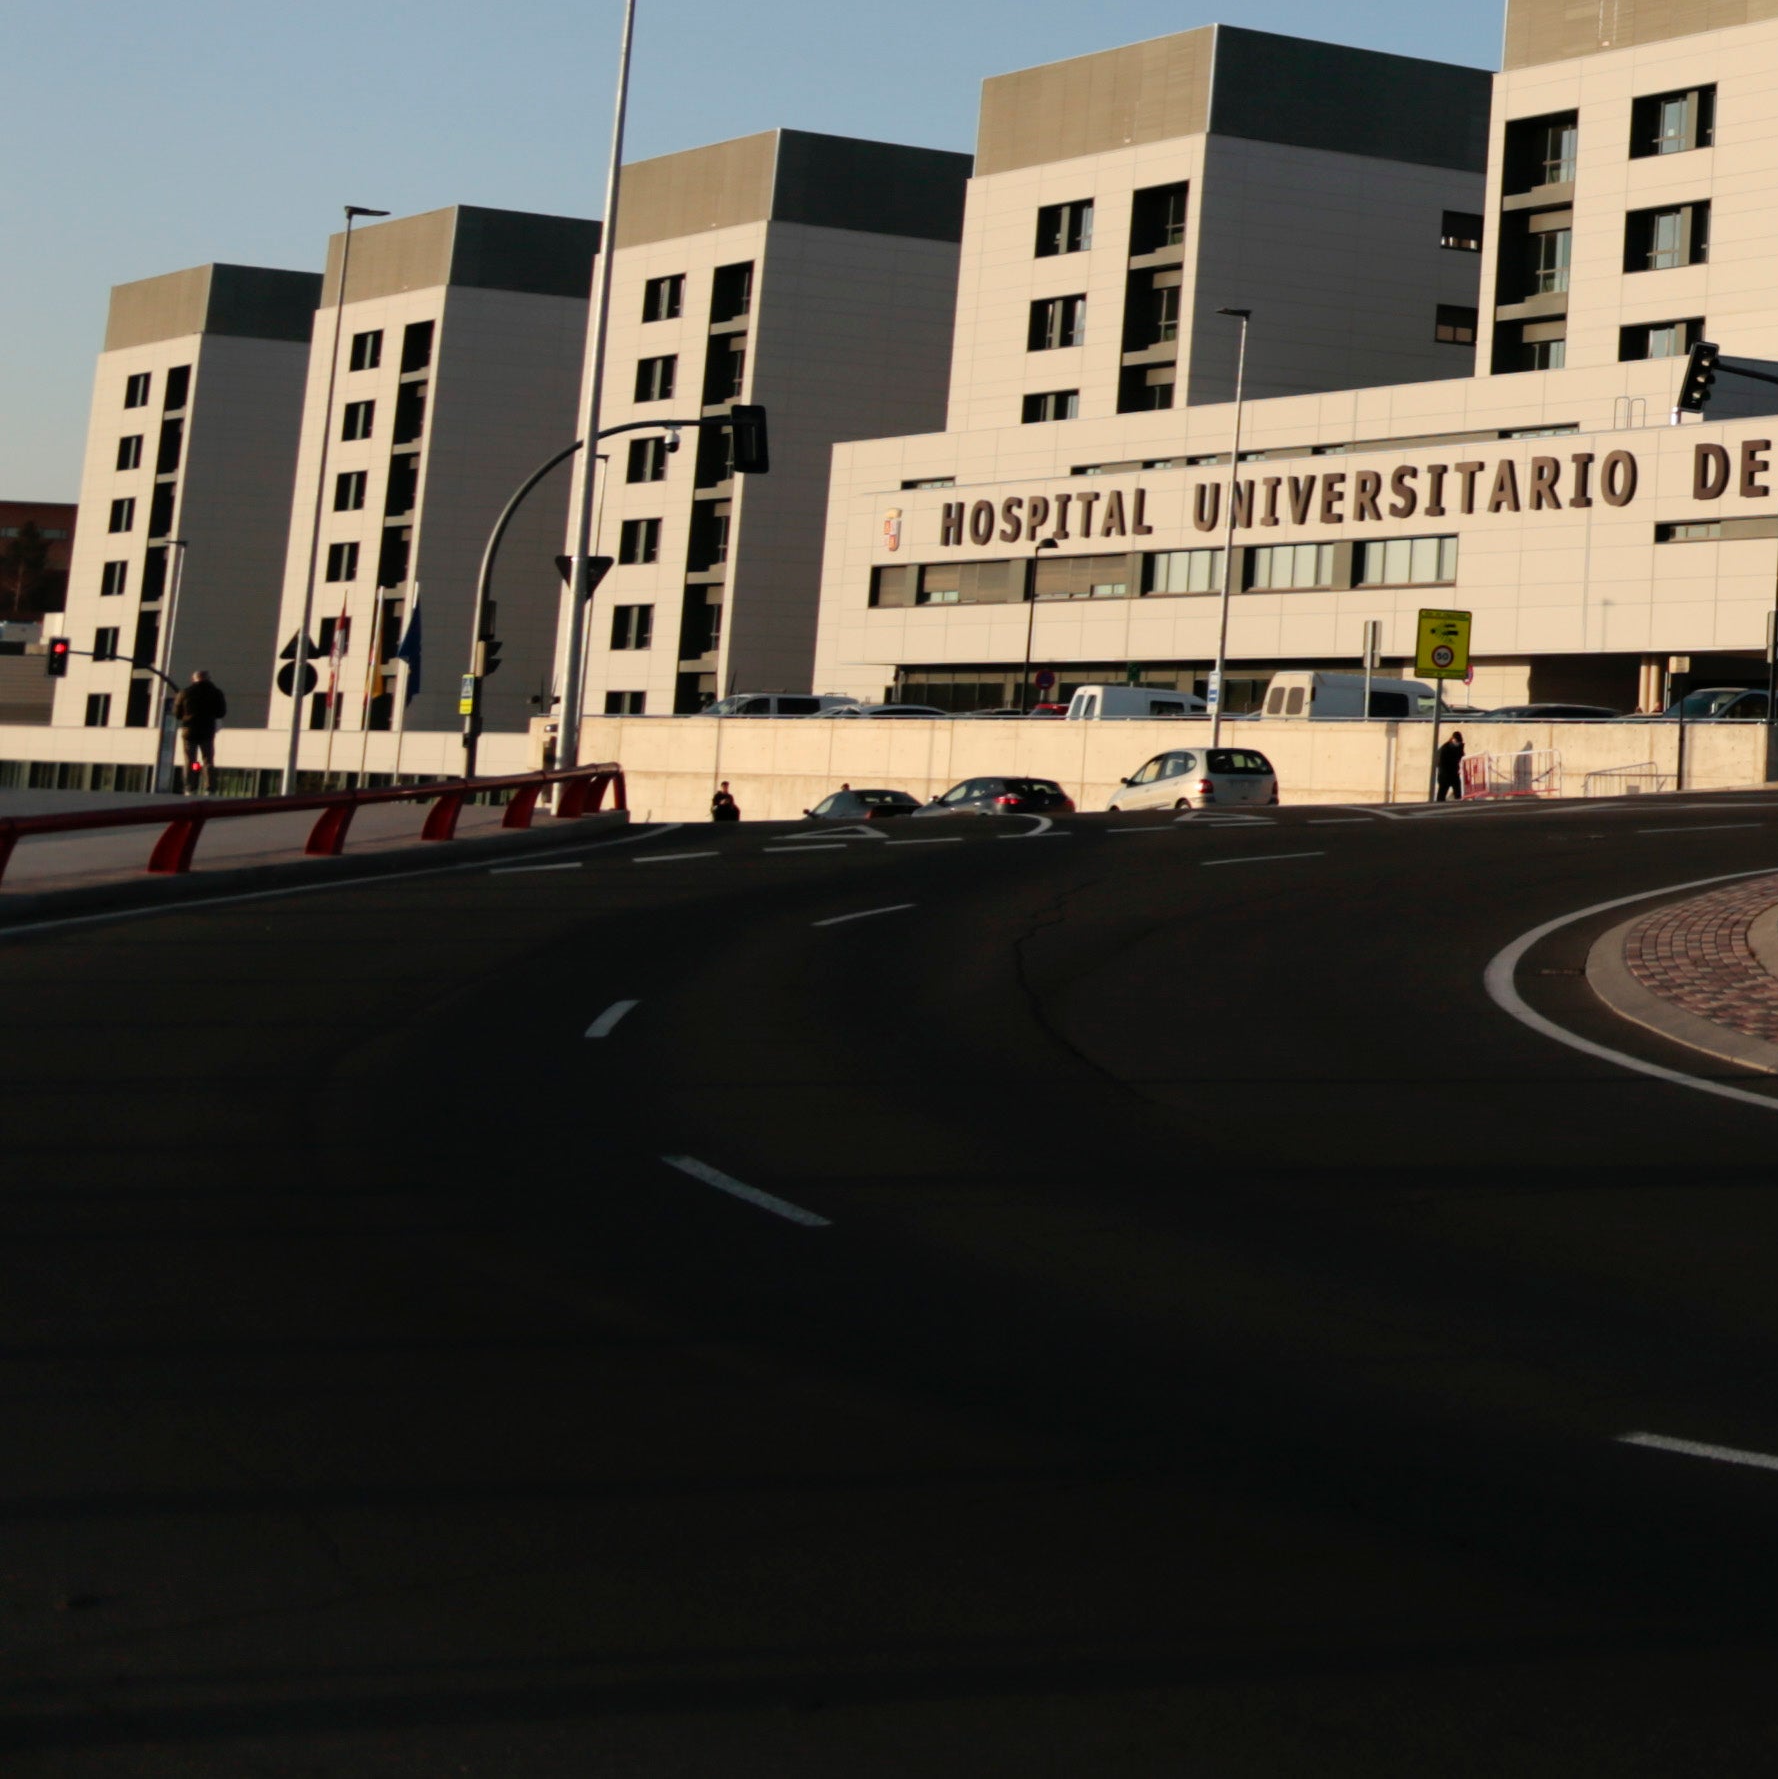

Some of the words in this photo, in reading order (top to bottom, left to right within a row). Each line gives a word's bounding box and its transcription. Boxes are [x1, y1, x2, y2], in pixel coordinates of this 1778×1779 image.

[940, 488, 1153, 546] HOSPITAL
[1193, 449, 1638, 532] UNIVERSITARIO
[1693, 439, 1771, 500] DE
